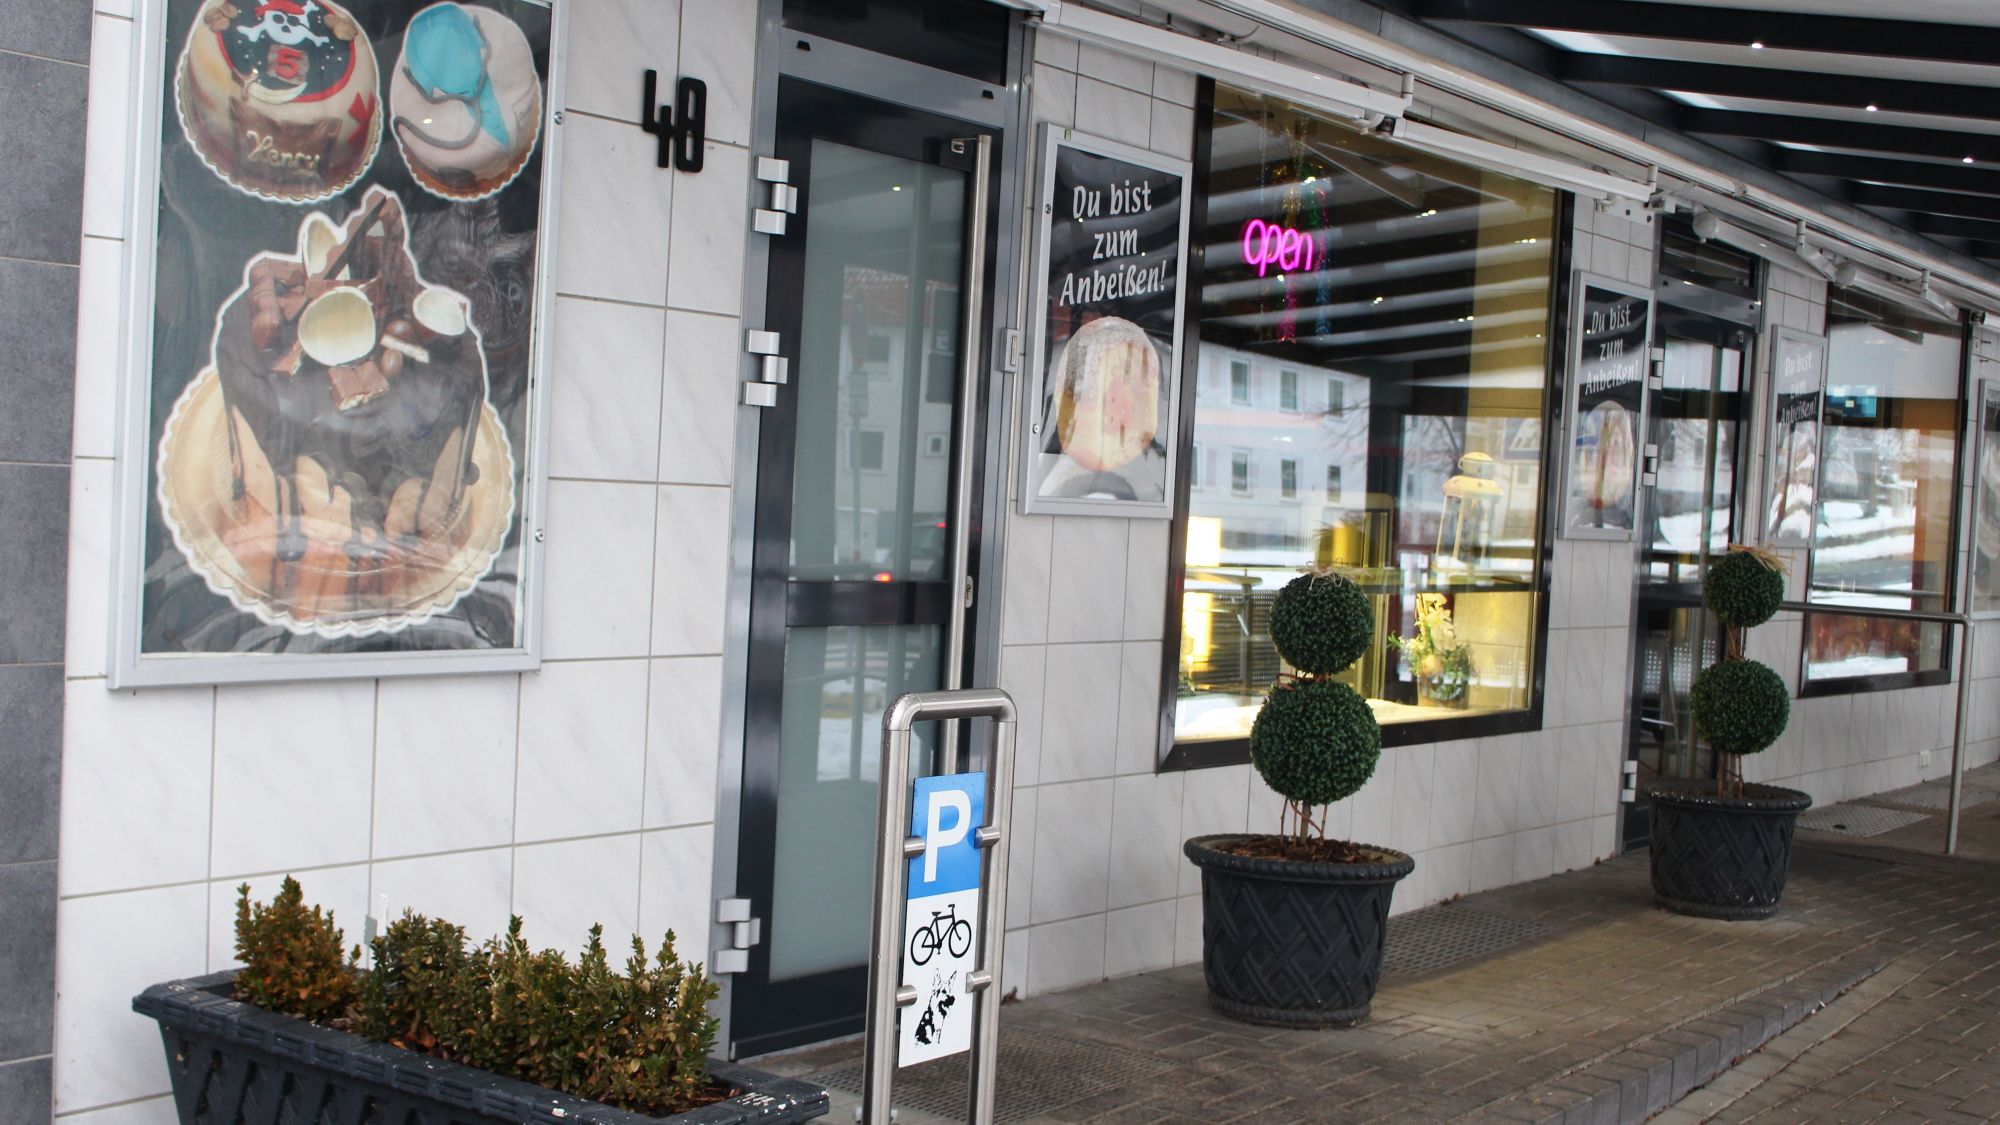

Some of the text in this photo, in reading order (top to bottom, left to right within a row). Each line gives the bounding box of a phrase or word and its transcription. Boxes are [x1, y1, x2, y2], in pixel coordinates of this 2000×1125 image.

[274, 50, 301, 79] 5
[642, 69, 707, 173] 48
[1072, 179, 1152, 219] Du bist
[1092, 228, 1138, 260] zum
[1059, 259, 1168, 307] Anbeißen!
[1591, 304, 1632, 335] Du bist
[1599, 338, 1624, 362] zum
[1585, 359, 1640, 396] Anbeißen!
[923, 789, 972, 883] P
